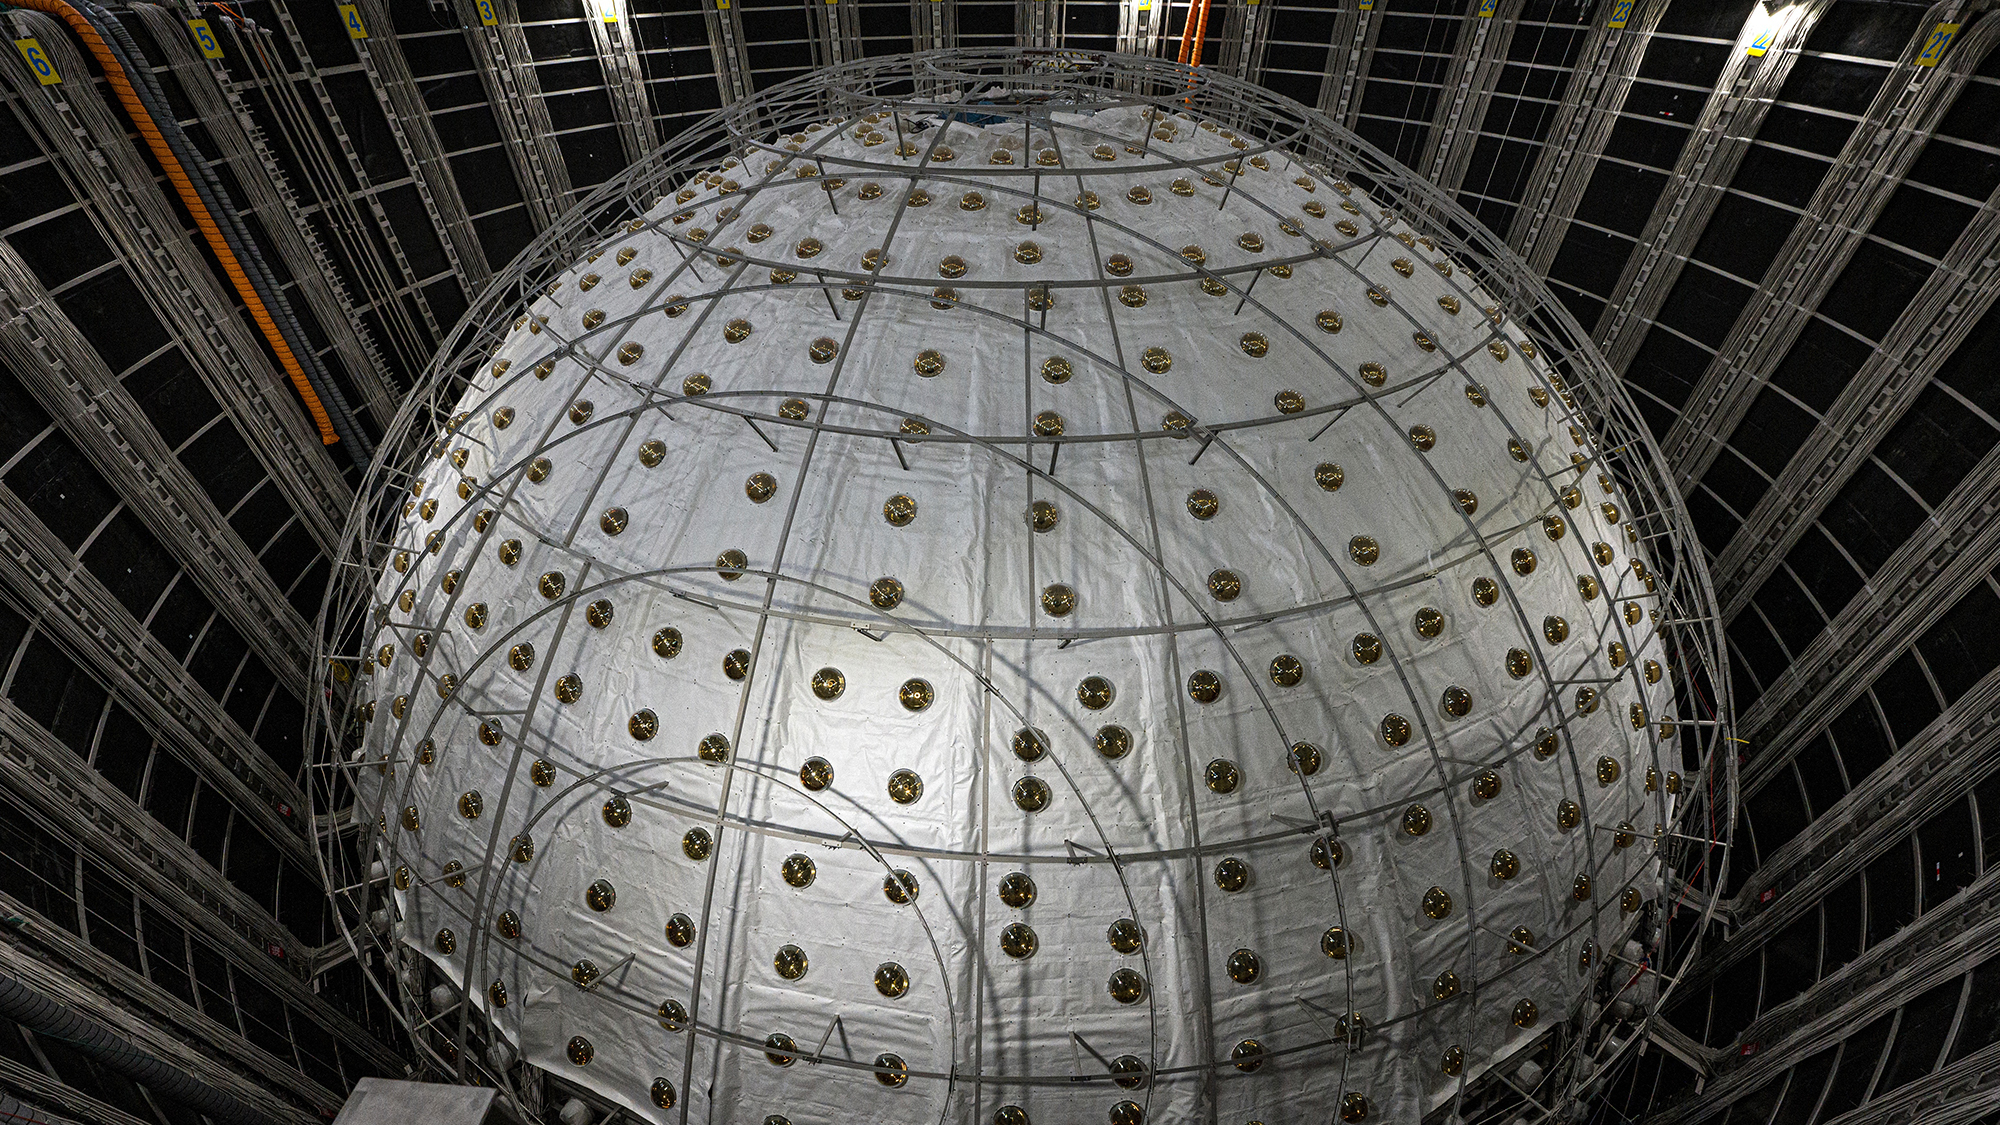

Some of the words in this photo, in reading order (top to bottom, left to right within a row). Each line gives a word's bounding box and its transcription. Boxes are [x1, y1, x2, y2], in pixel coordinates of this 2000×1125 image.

[349, 11, 361, 32] 4
[480, 1, 493, 21] 3
[1611, 1, 1632, 23] 23
[195, 26, 215, 51] 5
[1921, 31, 1952, 59] 21
[26, 47, 51, 77] 6
